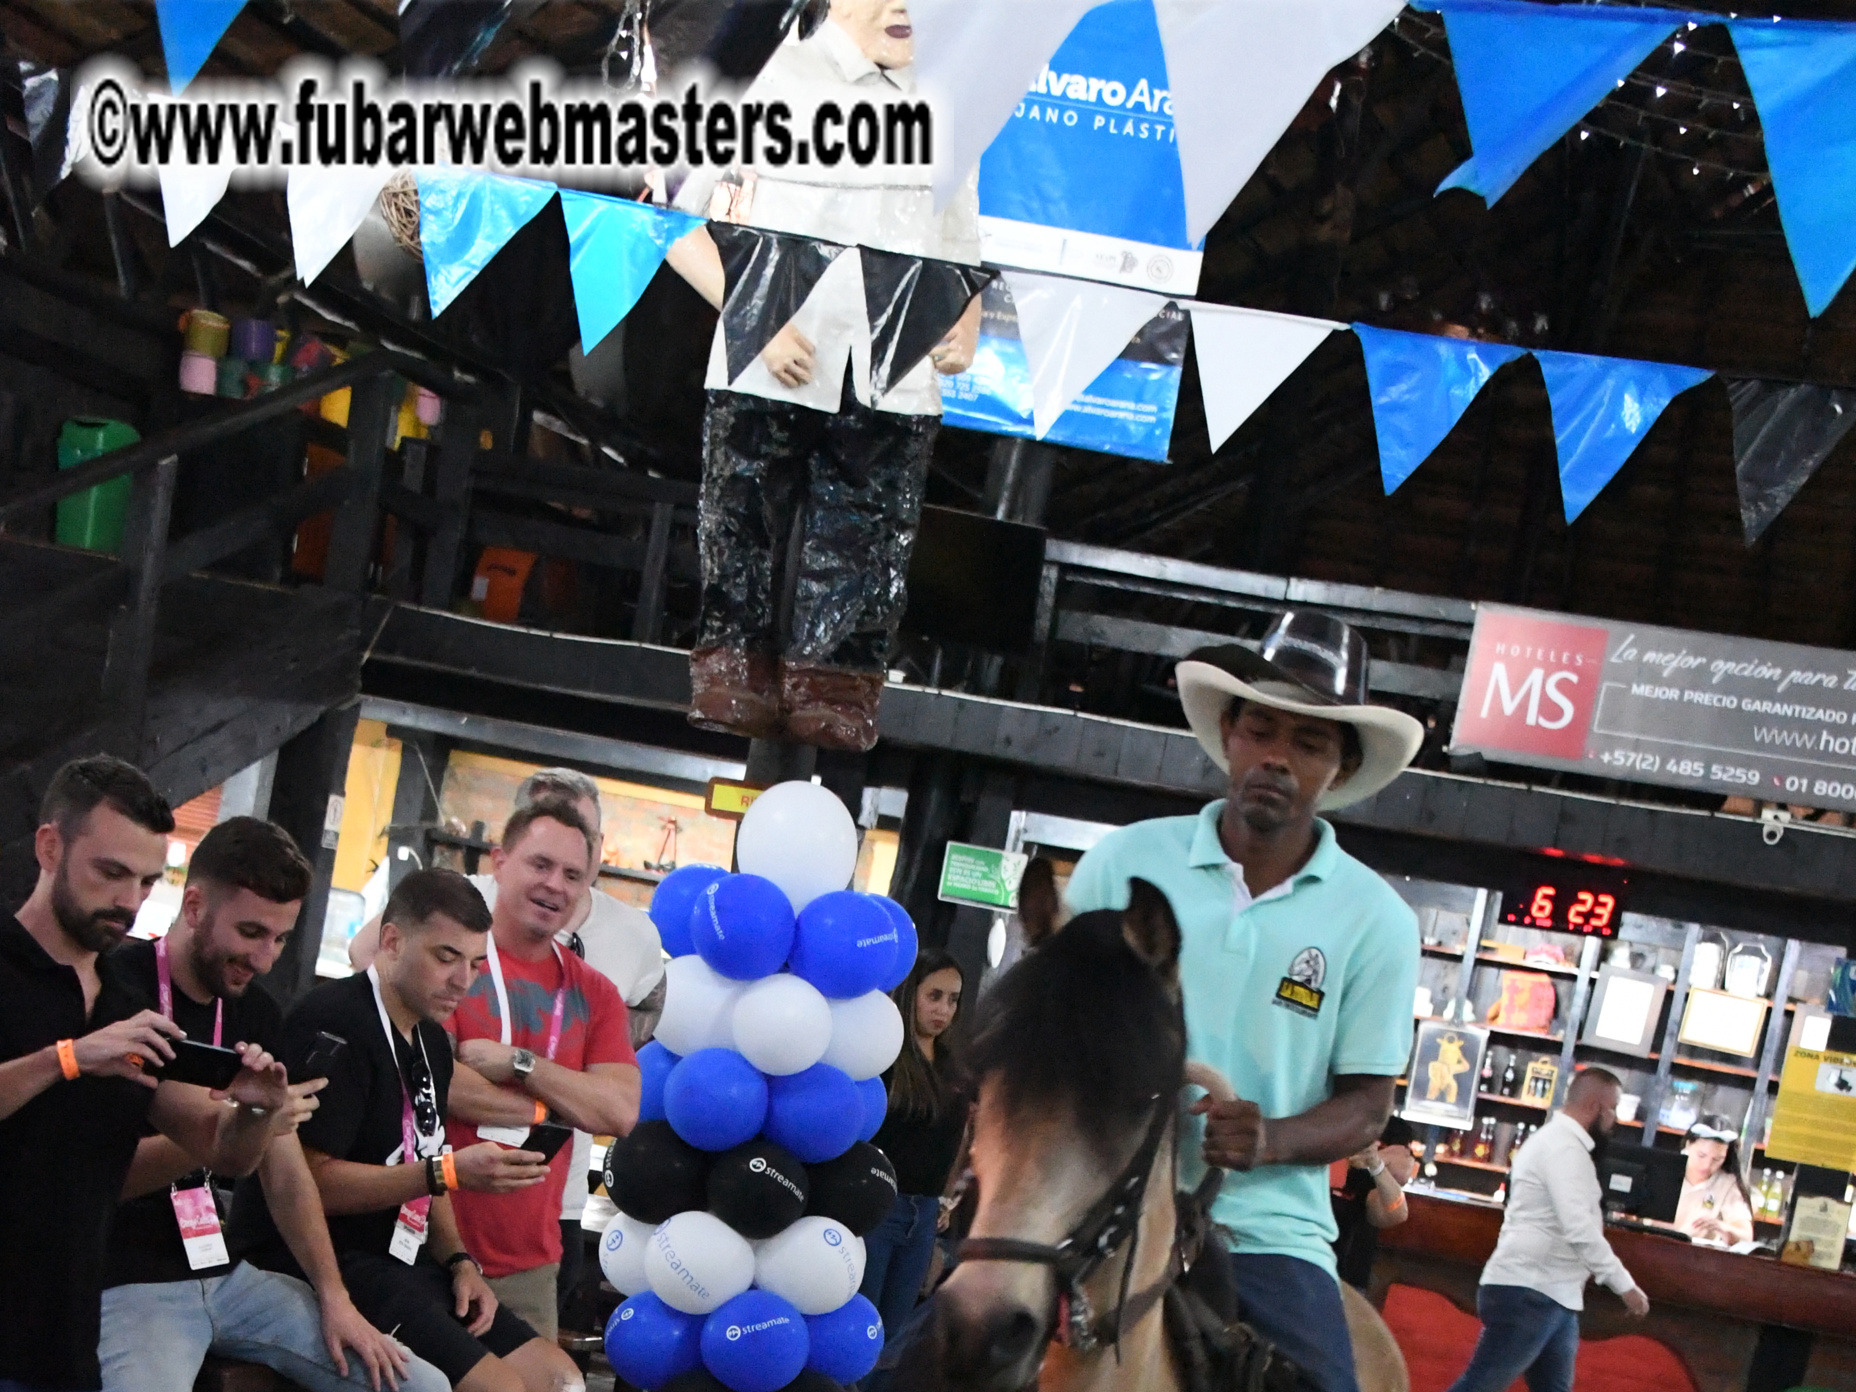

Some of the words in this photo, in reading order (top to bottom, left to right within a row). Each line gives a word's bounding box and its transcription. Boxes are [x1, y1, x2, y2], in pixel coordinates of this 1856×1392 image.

[1495, 642, 1584, 666] HOTELES
[1609, 632, 1639, 664] La
[1641, 649, 1708, 678] mejor
[1710, 658, 1782, 684] opción
[1776, 669, 1839, 693] para
[1480, 661, 1579, 730] MS
[1631, 682, 1681, 701] MEJOR
[1683, 689, 1738, 709] PRECIO
[1741, 698, 1848, 725] GARANTIZADO
[1600, 748, 1661, 773] +57(2)
[1665, 758, 1705, 778] 485
[1709, 763, 1761, 786] 5259
[1785, 775, 1809, 794] 01
[764, 1166, 805, 1203] streamate
[656, 1232, 710, 1300] streamate
[741, 1316, 791, 1336] streamate
